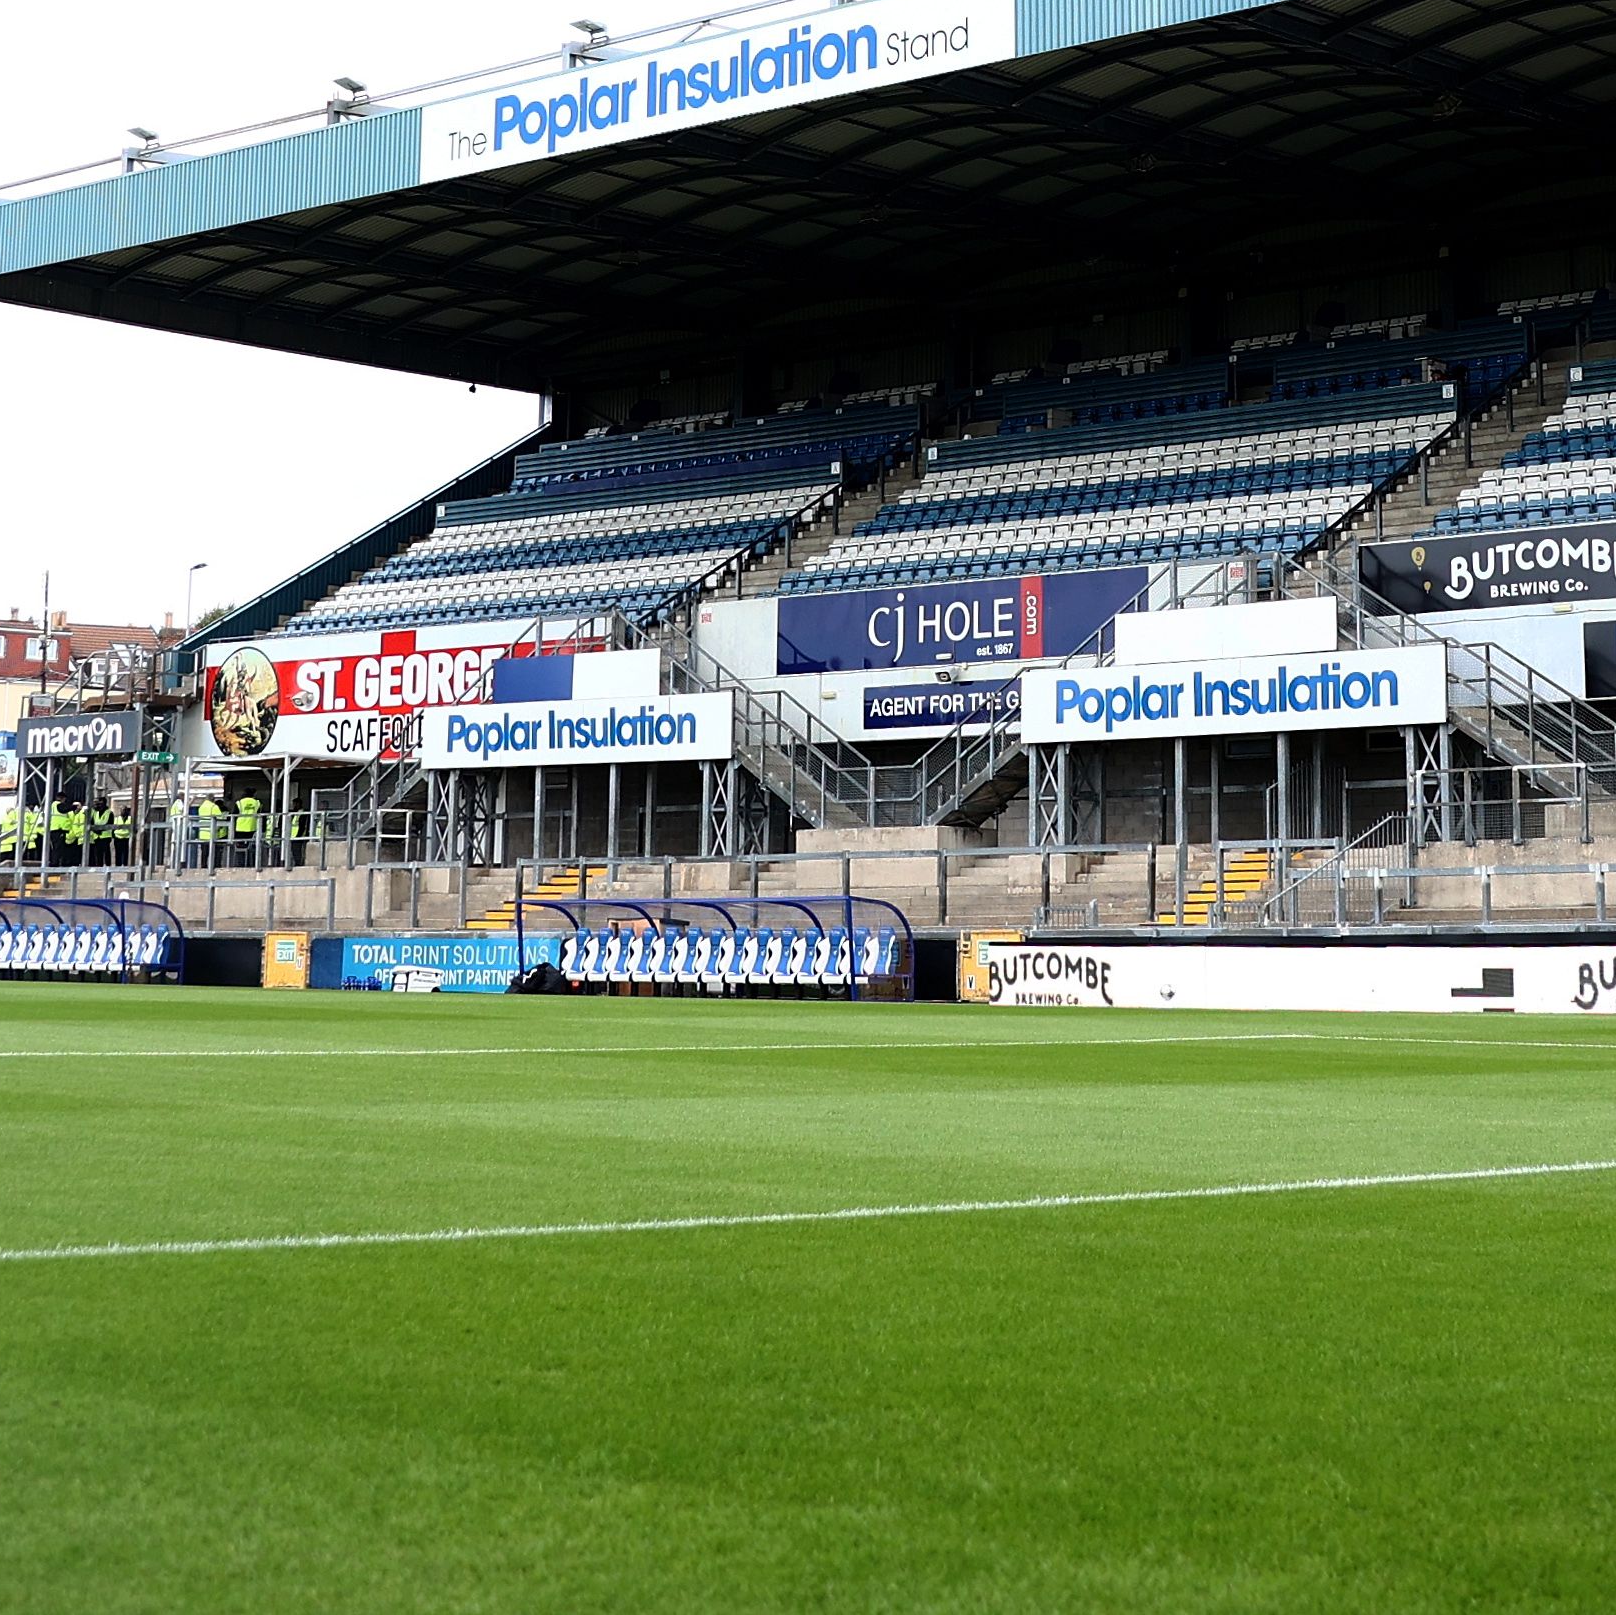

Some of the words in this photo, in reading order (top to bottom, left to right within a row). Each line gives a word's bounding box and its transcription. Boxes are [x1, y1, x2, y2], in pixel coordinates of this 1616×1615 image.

[448, 131, 488, 161] The
[493, 77, 638, 154] Poplar
[646, 23, 878, 118] Insulation
[886, 16, 969, 66] Stand
[1490, 580, 1560, 598] BREWING
[1565, 578, 1588, 591] Co.
[868, 592, 905, 663] cj
[918, 597, 1014, 643] HOLE
[1025, 591, 1037, 635] .com
[976, 645, 992, 656] est.
[994, 643, 1014, 655] 1867
[296, 658, 346, 712] ST.
[869, 695, 926, 717] AGENT
[929, 693, 965, 714] FOR
[968, 691, 1002, 711] THE
[1005, 690, 1021, 710] G
[1056, 674, 1184, 733] Poplar
[1193, 662, 1399, 717] Insulation
[27, 717, 123, 754] macron
[447, 712, 542, 762] Poplar
[548, 704, 697, 749] Insulation
[141, 751, 160, 761] EXIT
[352, 944, 398, 965] TOTAL
[400, 944, 450, 965] PRINT
[453, 944, 549, 966] SOLUTIONS
[438, 969, 464, 985] RINT
[466, 969, 521, 986] PARTNE
[989, 951, 1113, 1006] BUTCOMBE
[1015, 993, 1063, 1006] BREWING
